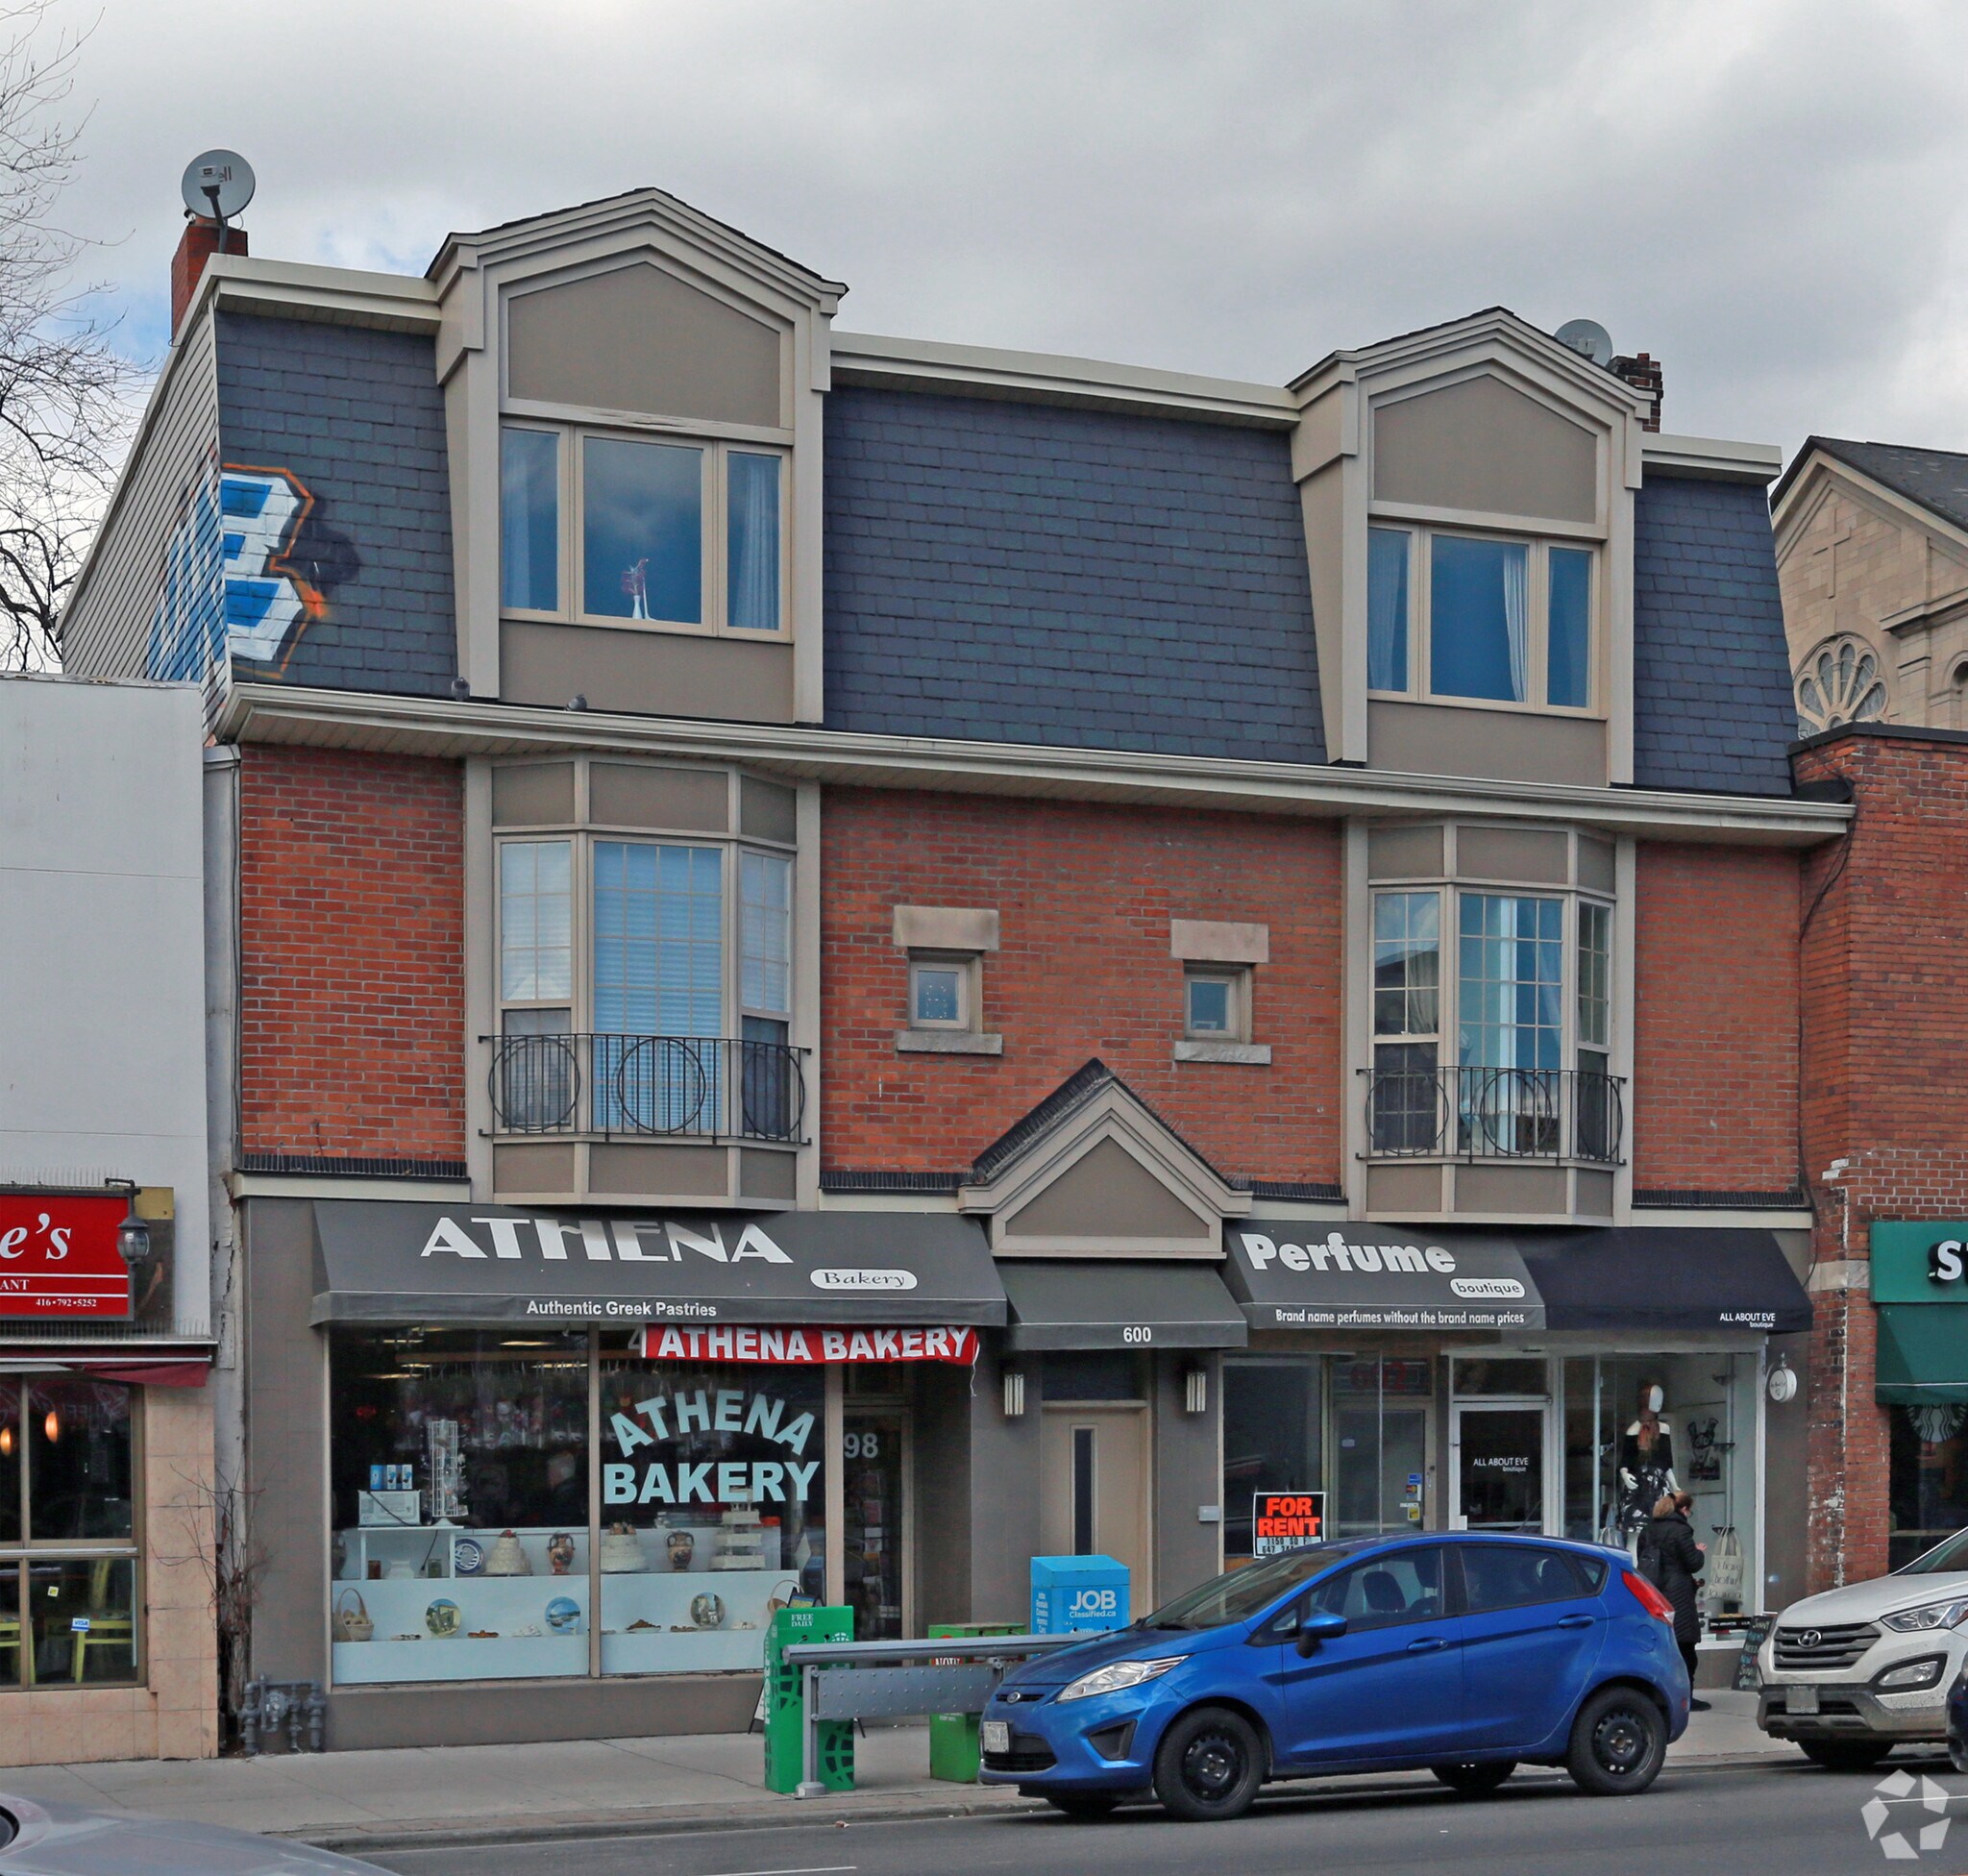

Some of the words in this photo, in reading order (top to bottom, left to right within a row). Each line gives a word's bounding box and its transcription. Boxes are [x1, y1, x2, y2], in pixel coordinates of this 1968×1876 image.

[420, 1217, 794, 1263] ATHENA
[1240, 1232, 1456, 1273] Perfume
[1937, 1240, 1968, 1280] S
[824, 1271, 905, 1288] Bakery
[1455, 1281, 1520, 1296] boutique
[527, 1300, 602, 1315] Authentic
[605, 1300, 652, 1316] Greek
[655, 1301, 717, 1317] Pastries
[1275, 1308, 1305, 1321] Brand
[1307, 1312, 1335, 1322] name
[1337, 1310, 1381, 1325] perfumes
[1384, 1311, 1418, 1323] without
[1420, 1311, 1436, 1324] the
[1438, 1311, 1466, 1324] brand
[1468, 1314, 1495, 1324] name
[1497, 1312, 1524, 1326] prices
[1719, 1313, 1734, 1321] ALL
[1734, 1313, 1760, 1321] ABOUT
[1761, 1313, 1776, 1321] EVE
[657, 1324, 812, 1361] ATHENA
[821, 1325, 971, 1361] BAKERY
[1123, 1326, 1152, 1343] 600
[610, 1390, 815, 1457] ATHENA
[1473, 1458, 1487, 1467] ALL
[1488, 1458, 1513, 1467] ABOUT
[1514, 1457, 1529, 1466] EVE
[603, 1461, 820, 1504] BAKERY
[1267, 1497, 1312, 1517] FOR
[1258, 1518, 1320, 1536] RENT
[1069, 1590, 1117, 1610] JOB
[1069, 1610, 1117, 1618] Classified.ca
